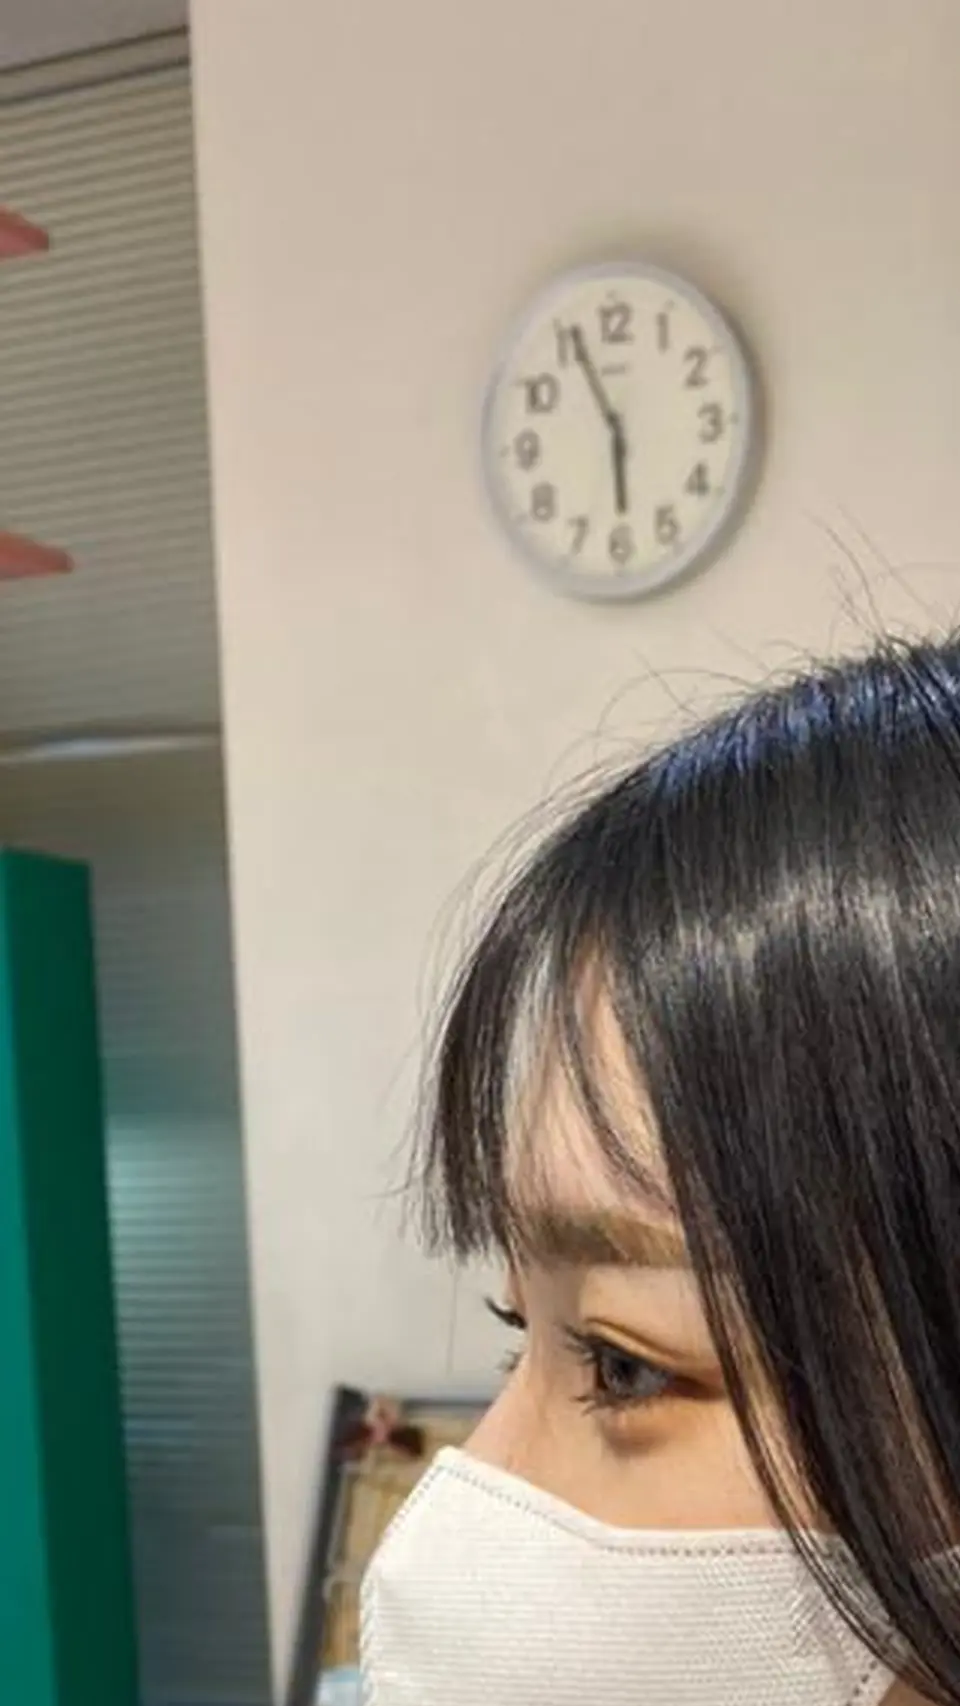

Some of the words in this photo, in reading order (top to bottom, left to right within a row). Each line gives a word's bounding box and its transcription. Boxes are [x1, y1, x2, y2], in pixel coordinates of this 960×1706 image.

[599, 303, 634, 344] 12
[656, 312, 669, 353] 1
[683, 345, 708, 388] 2
[524, 373, 560, 415] 10
[697, 403, 724, 444] 3
[513, 429, 540, 471] 9
[685, 463, 711, 497] 4
[530, 482, 557, 523] 8
[568, 516, 589, 555] 7
[609, 523, 637, 564] 6
[655, 504, 681, 545] 5
